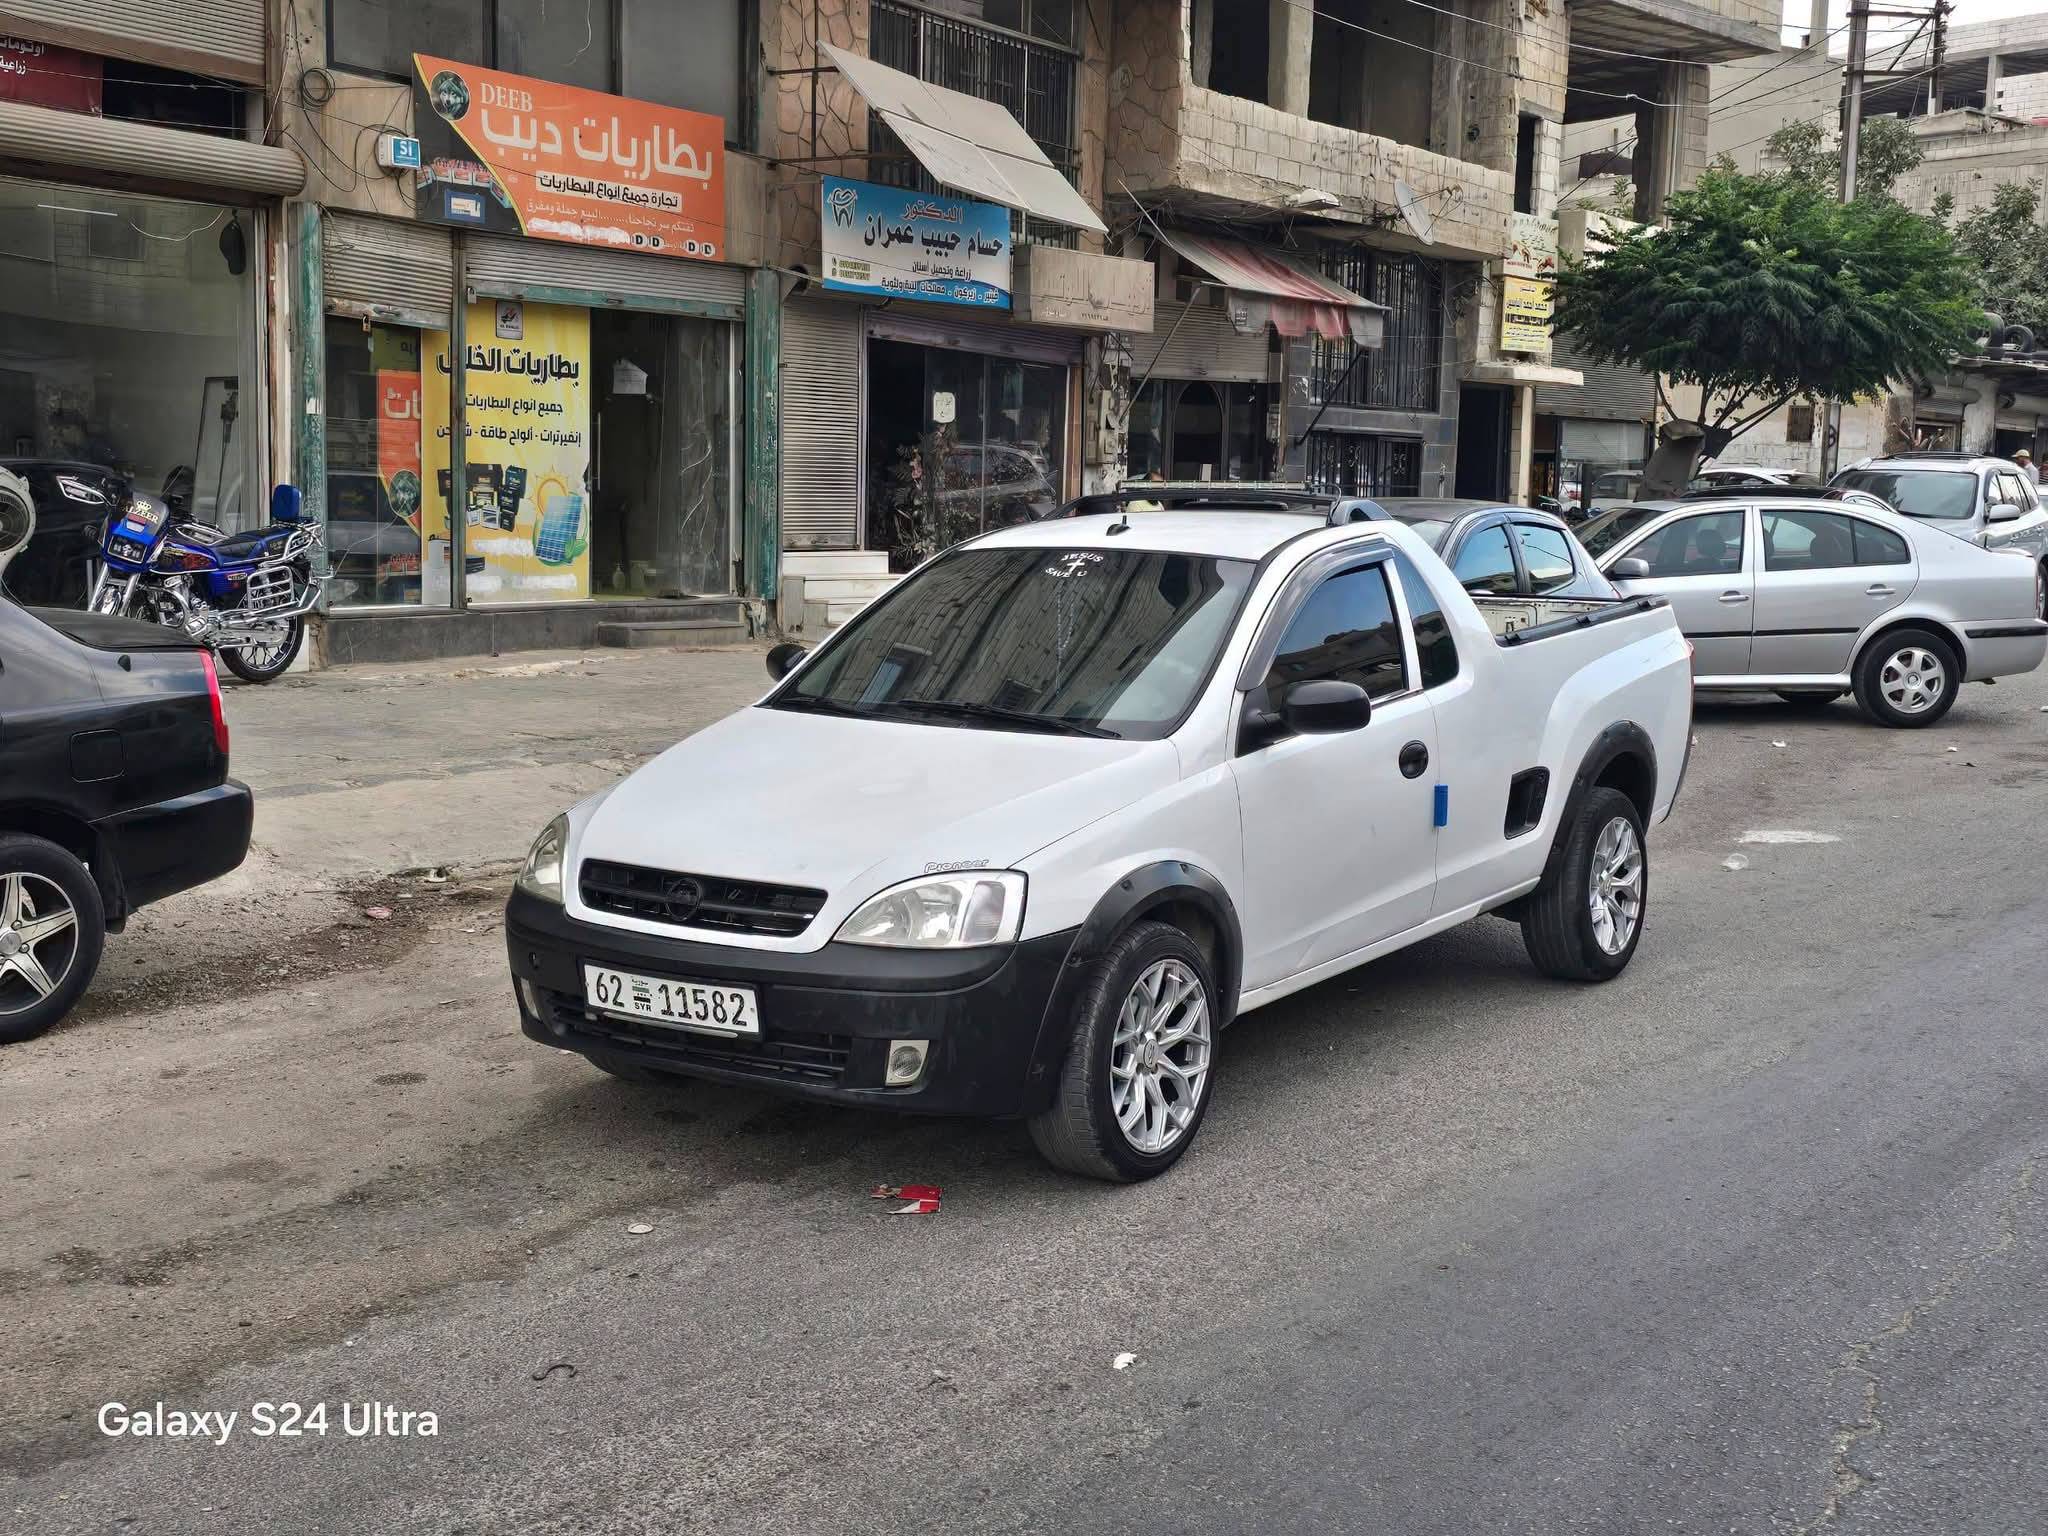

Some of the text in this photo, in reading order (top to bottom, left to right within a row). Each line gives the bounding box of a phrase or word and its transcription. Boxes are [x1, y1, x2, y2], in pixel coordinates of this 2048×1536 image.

[481, 83, 532, 112] DEEB
[481, 108, 713, 190] بطاريات ديب
[540, 175, 594, 198] البطاريات
[621, 187, 649, 206] جميع
[652, 191, 678, 208] تجارة
[900, 199, 964, 224] الدكتور
[864, 211, 1003, 260] حسام حبيب عمران
[436, 343, 502, 376] الخلل
[504, 348, 579, 388] بطاريات
[465, 394, 563, 417] جميع انواع البطاريات
[480, 425, 507, 440] طاقة
[540, 430, 582, 447] إنفيرترات
[1061, 552, 1104, 563] JESUS
[1045, 567, 1071, 578] SAVE
[924, 859, 989, 873] Pioneer
[596, 972, 748, 1027] 62 11582
[634, 1002, 652, 1012] SYR
